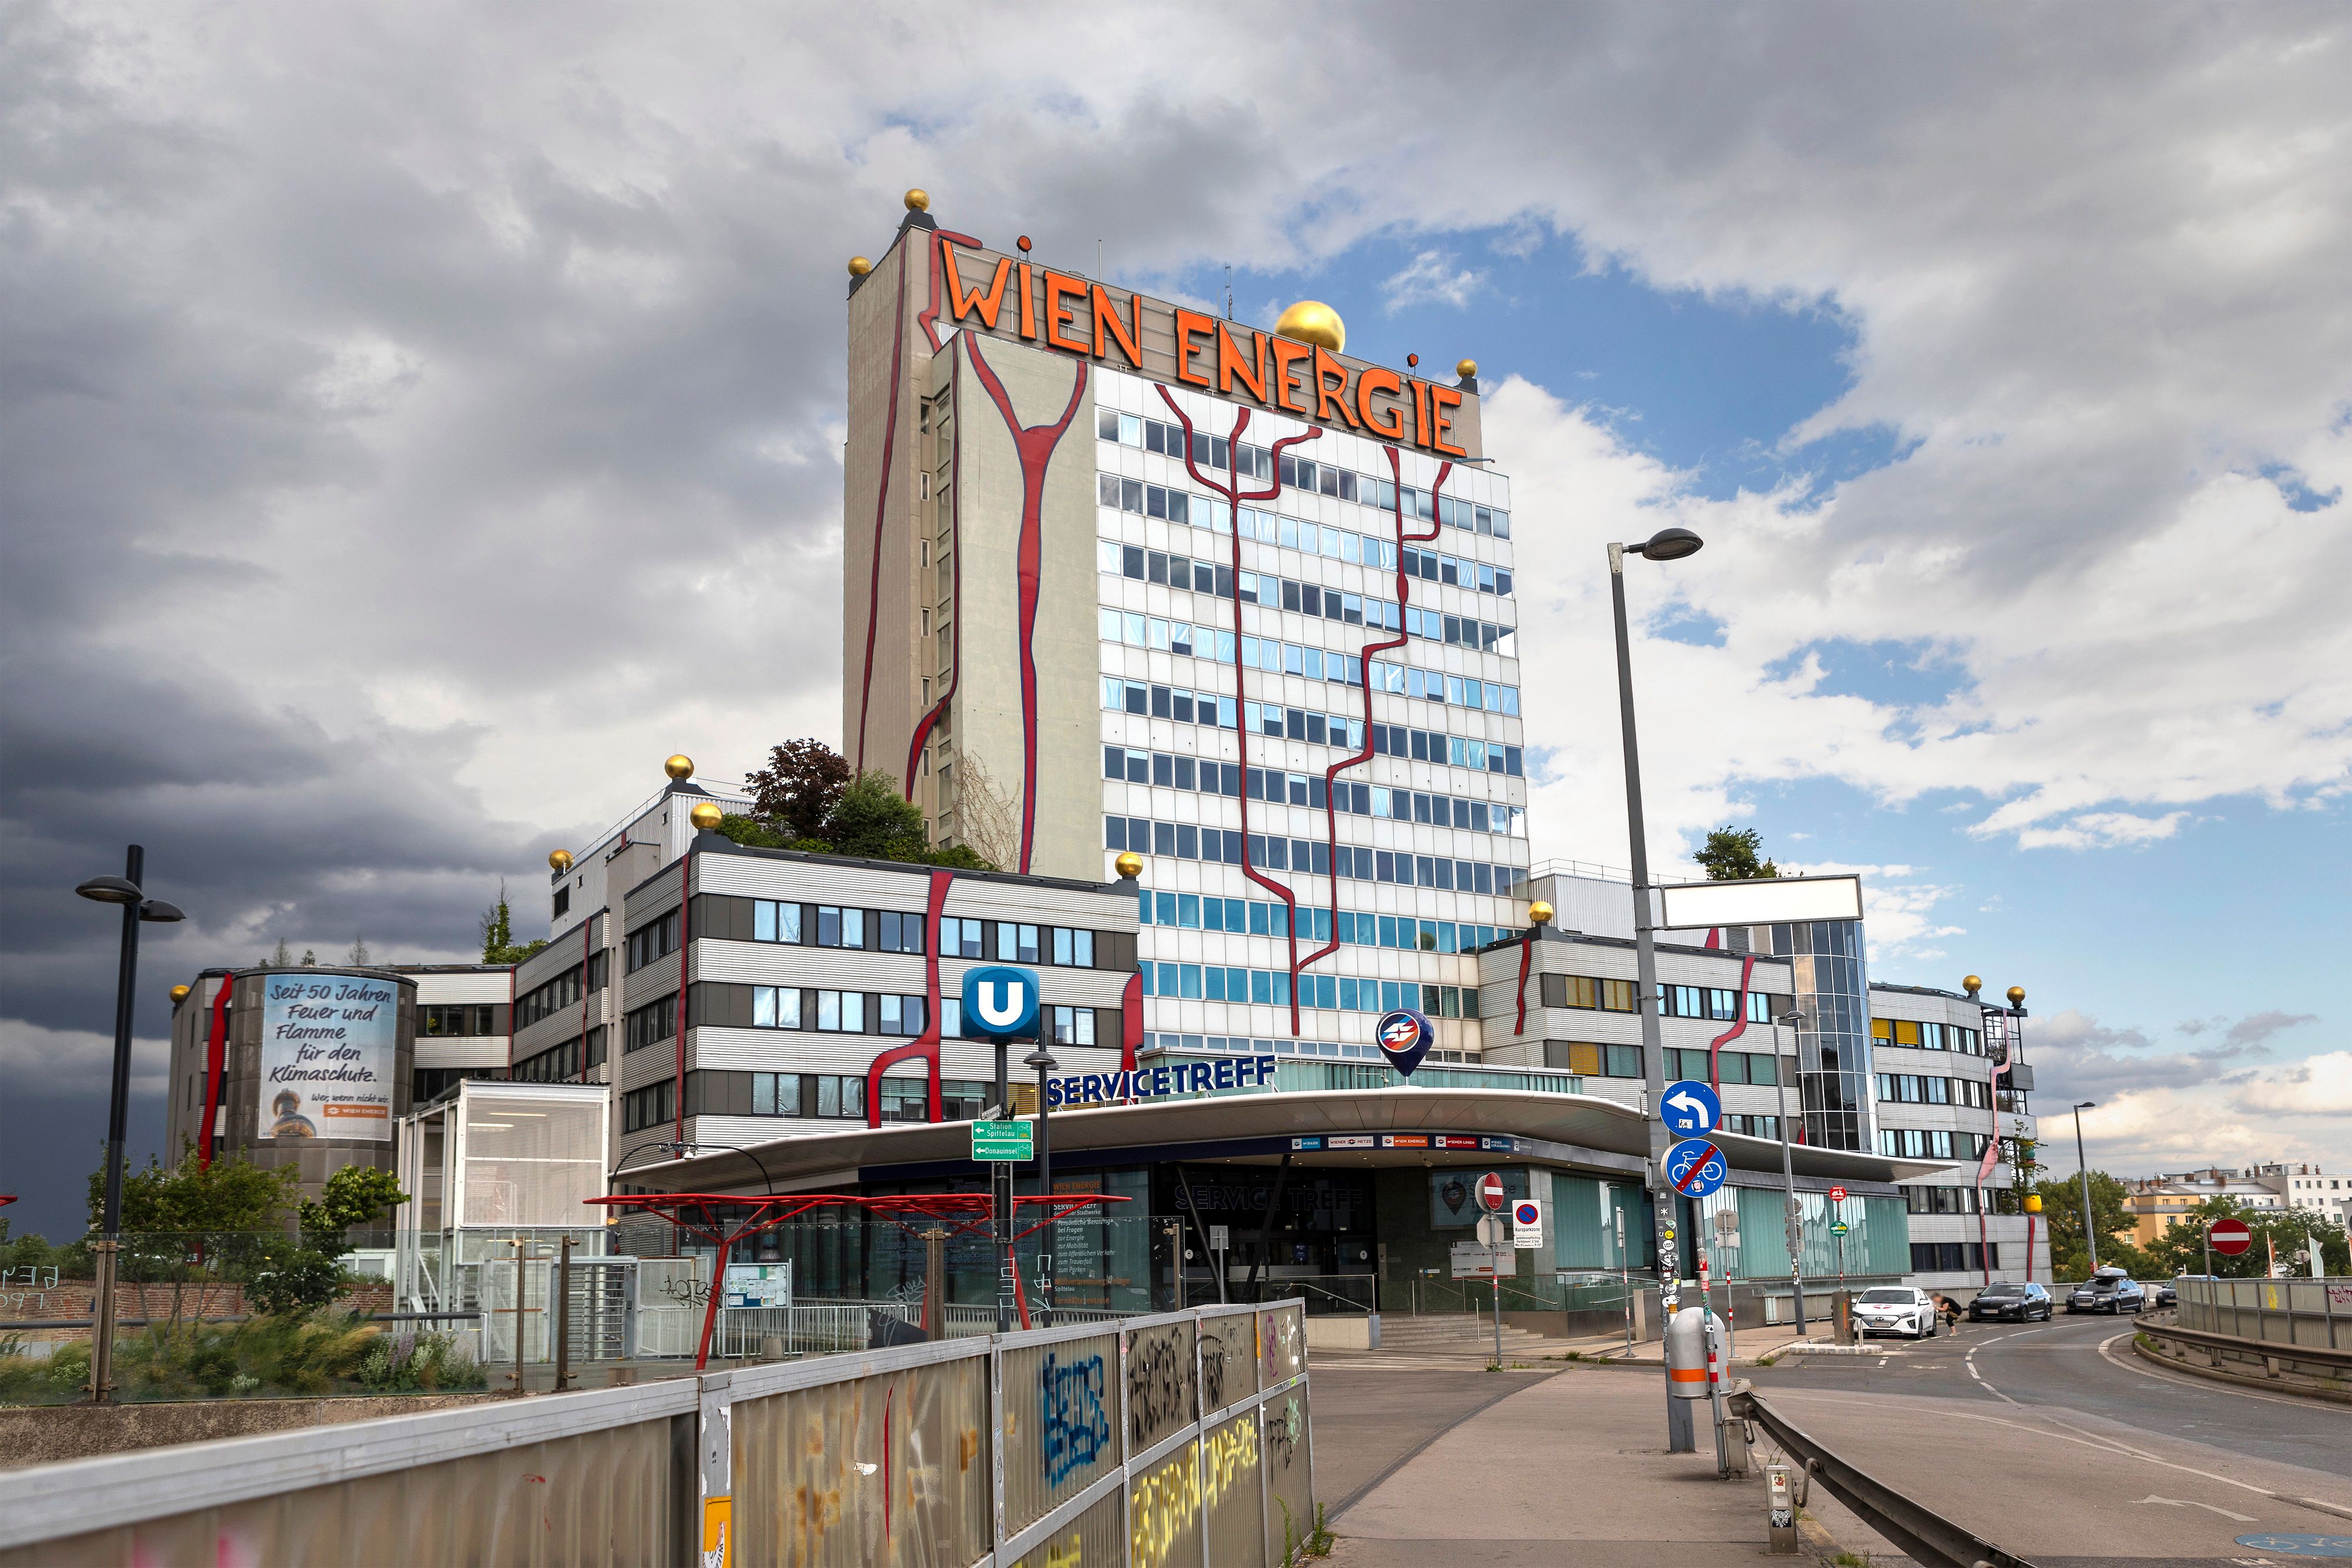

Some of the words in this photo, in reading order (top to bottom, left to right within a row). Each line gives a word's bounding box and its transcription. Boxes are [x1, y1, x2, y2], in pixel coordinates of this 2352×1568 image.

[939, 236, 1143, 370] WIEN
[1174, 309, 1468, 458] ENERGIE
[270, 983, 305, 1000] Seit
[306, 985, 331, 999] 50
[336, 983, 390, 1002] Jahren
[288, 1004, 339, 1019] Feuer
[342, 1004, 379, 1021] und
[978, 981, 1024, 1026] U
[276, 1023, 347, 1039] Flamme
[296, 1043, 326, 1064] für
[328, 1043, 361, 1061] den
[269, 1063, 377, 1083] Klimaschutz.
[1047, 1055, 1278, 1106] SERVICETREFF
[311, 1093, 330, 1102] Wer,
[356, 1093, 377, 1102] nicht
[987, 1129, 1015, 1138] Spittelau
[1053, 1182, 1070, 1191] WIEN
[1072, 1181, 1101, 1189] ENERGIE
[1175, 1185, 1281, 1210] SERVICE
[1288, 1188, 1362, 1211] TREFF
[944, 1251, 998, 1265] Bestattung
[1068, 1250, 1096, 1258] öffentlichen
